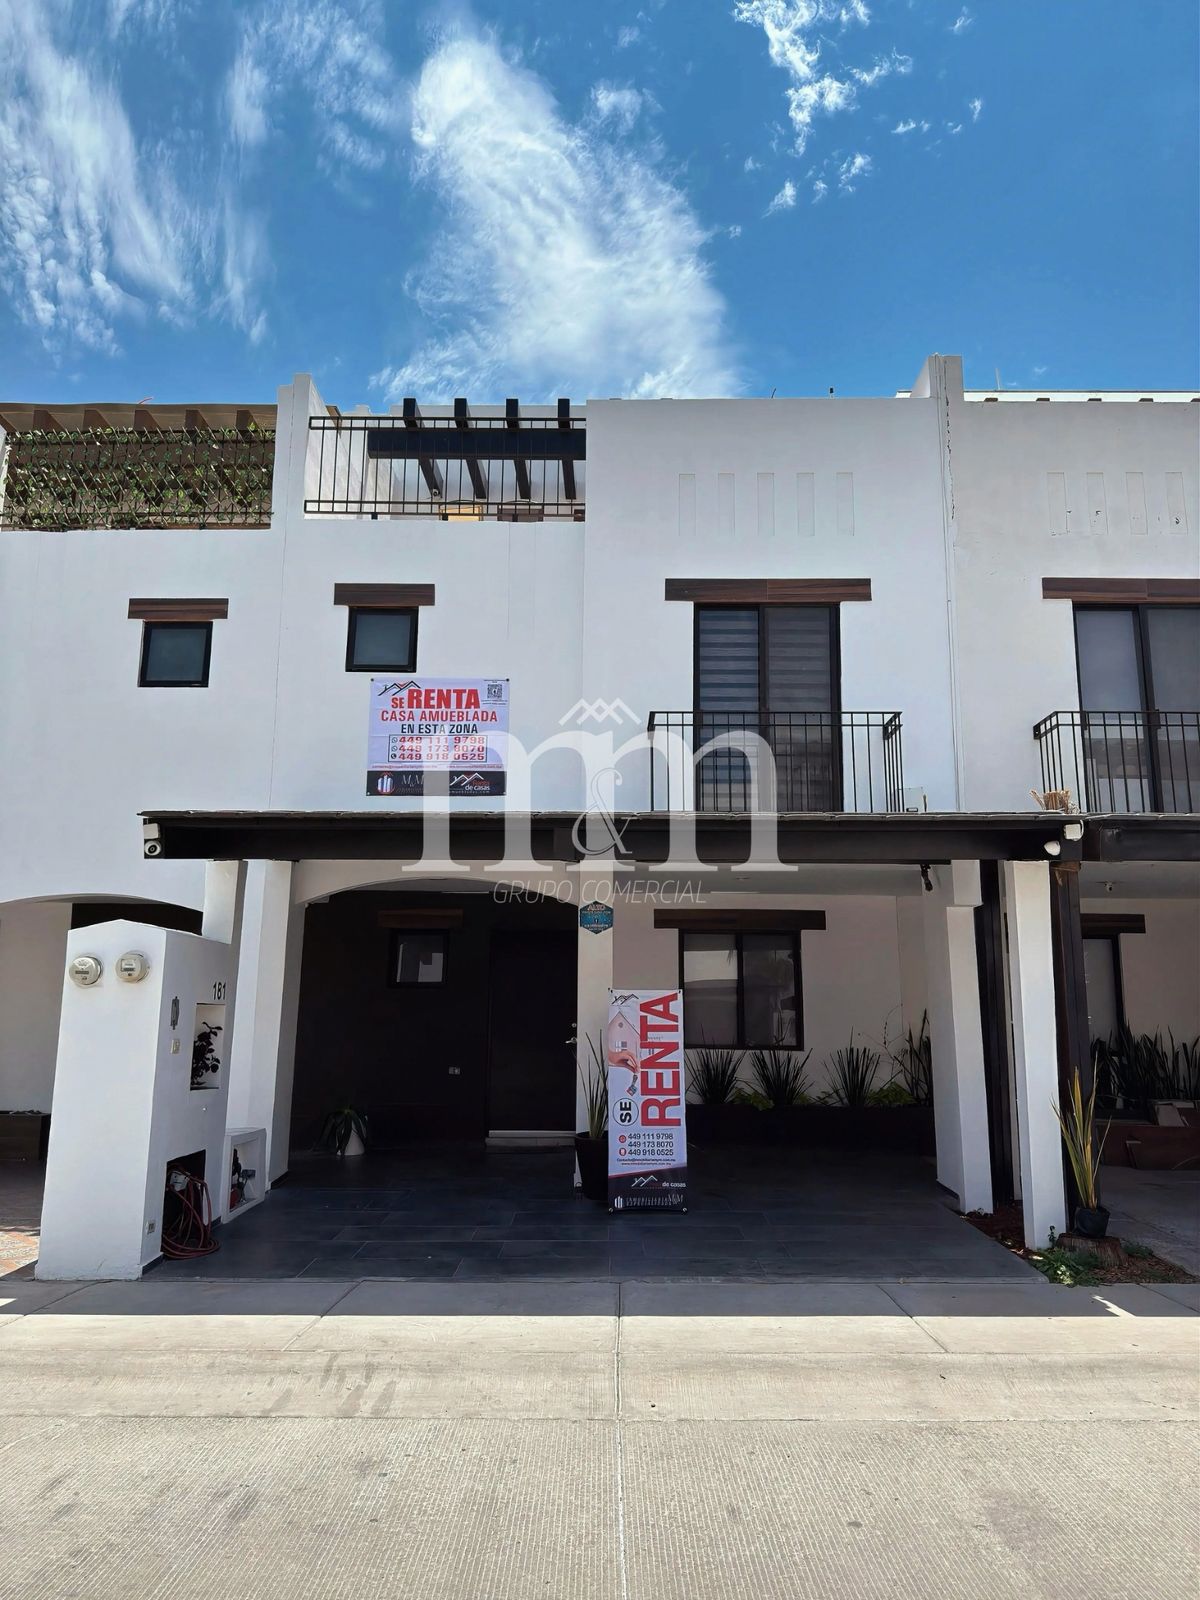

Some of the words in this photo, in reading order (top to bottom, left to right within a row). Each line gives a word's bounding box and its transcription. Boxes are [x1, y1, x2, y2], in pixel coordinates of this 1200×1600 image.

[391, 697, 405, 709] SE
[407, 688, 481, 709] RENTA
[381, 710, 416, 722] CASA
[419, 711, 498, 722] AMUEBLADA
[401, 724, 415, 734] EN
[418, 724, 446, 734] ESTA
[448, 724, 478, 734] ZONA
[399, 736, 422, 744] 449
[429, 736, 449, 744] 111
[453, 736, 485, 744] 9798
[399, 745, 422, 753] 449
[428, 745, 449, 753] 173
[399, 753, 422, 761] 449
[426, 753, 449, 761] 918
[453, 753, 485, 761] 0525
[213, 981, 227, 1000] 181
[640, 992, 681, 1126] RENTA
[620, 1101, 632, 1123] SE
